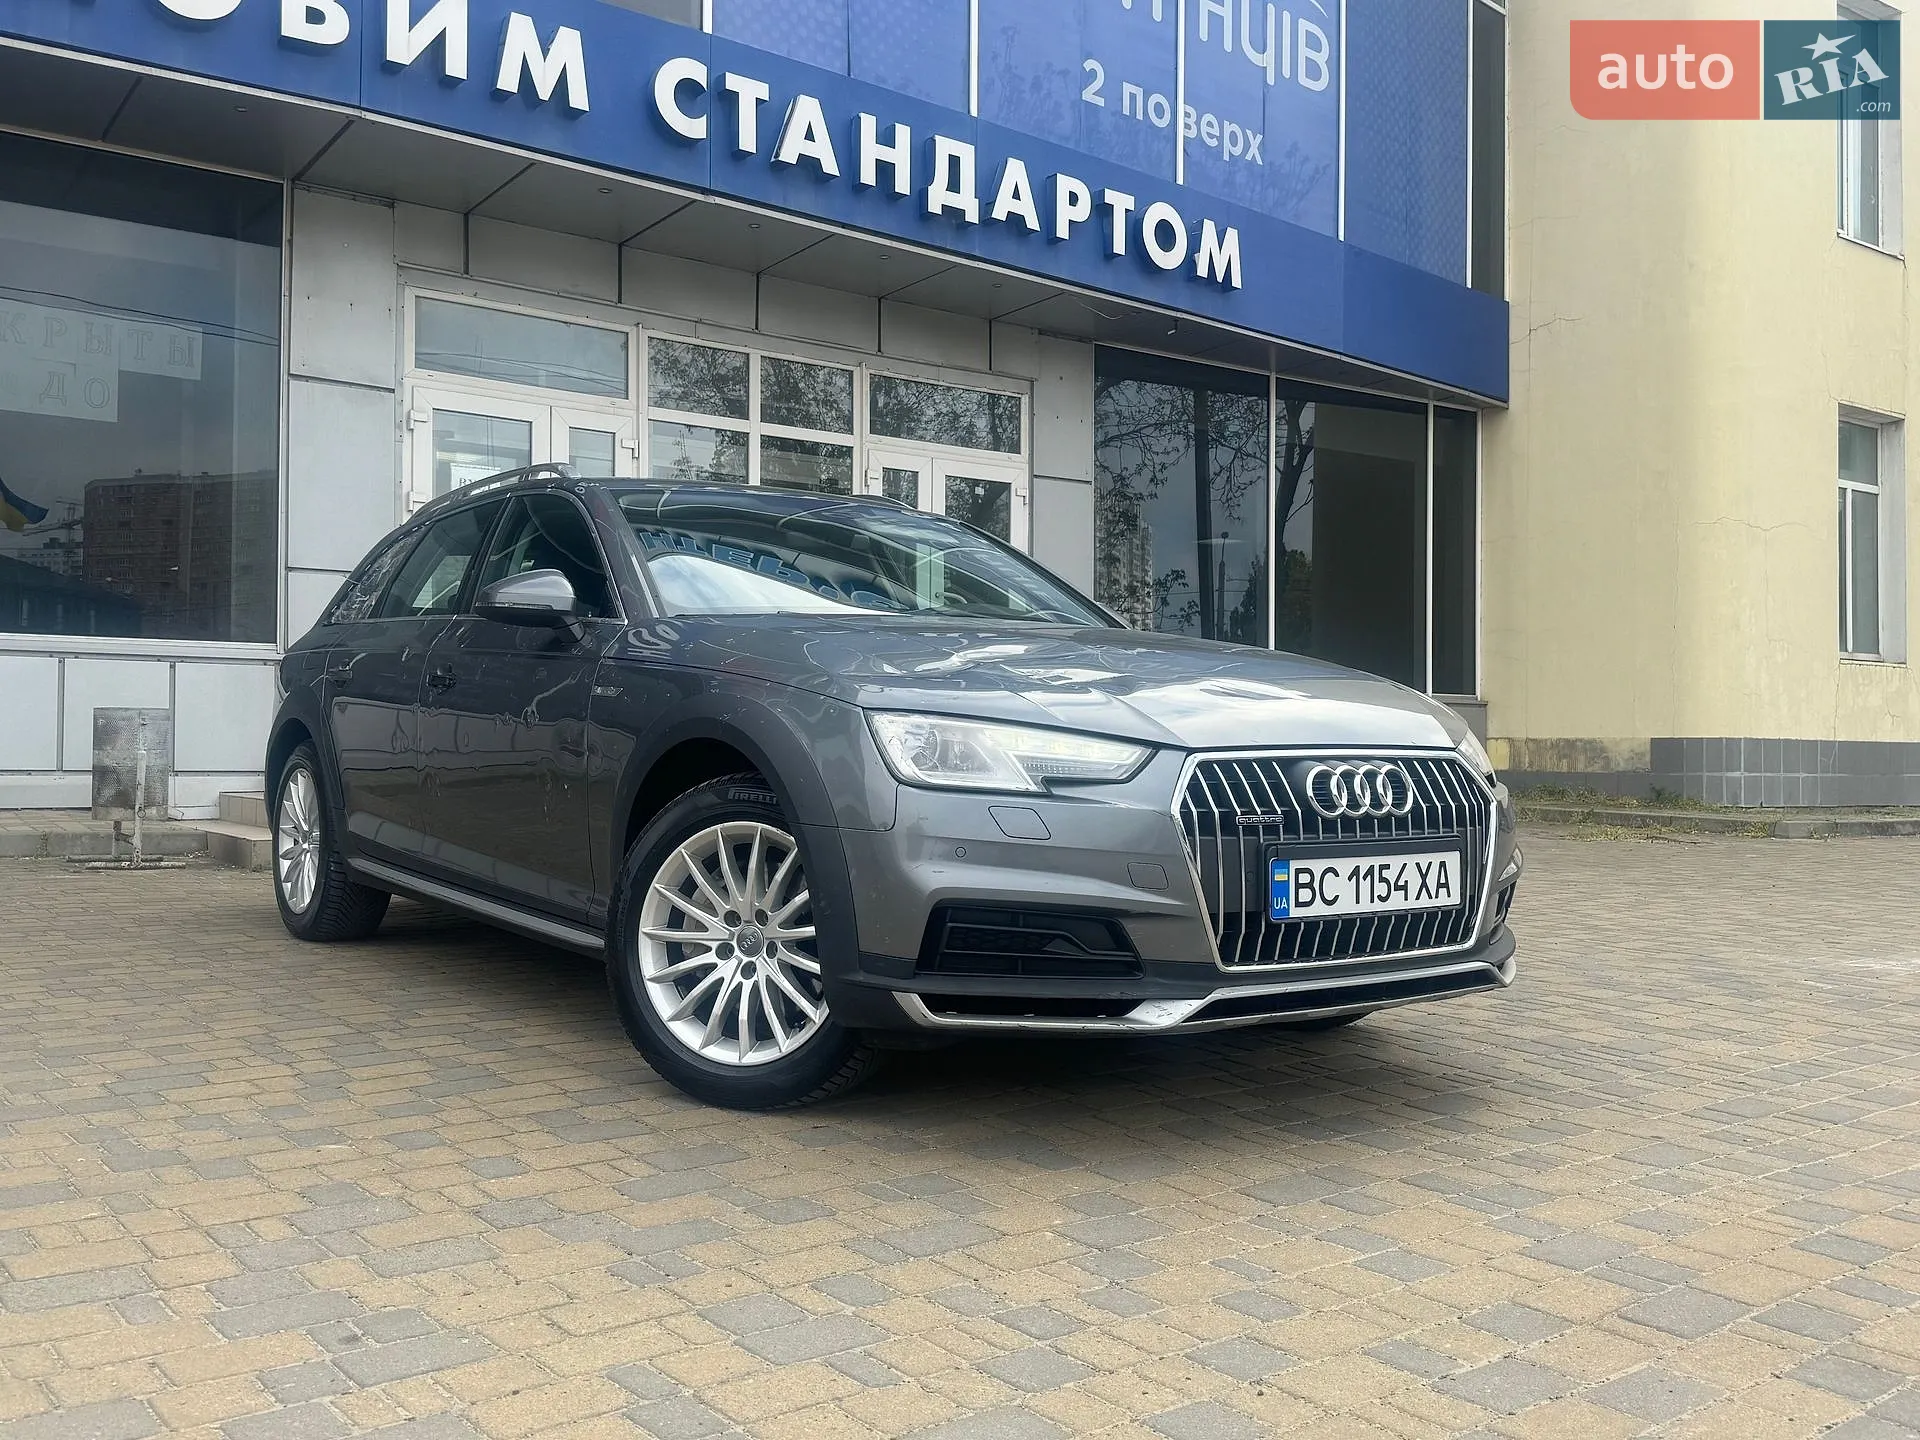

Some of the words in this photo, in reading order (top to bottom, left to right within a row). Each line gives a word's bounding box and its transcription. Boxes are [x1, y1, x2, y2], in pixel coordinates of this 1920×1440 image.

[1082, 59, 1105, 107] 2
[1122, 81, 1263, 165] поверх
[653, 57, 1243, 290] СТАНДАРТОМ
[1237, 816, 1283, 825] quattro
[1273, 897, 1288, 910] UA
[1294, 866, 1340, 908] BC
[1347, 863, 1409, 904] 1154
[1415, 860, 1451, 901] XA
